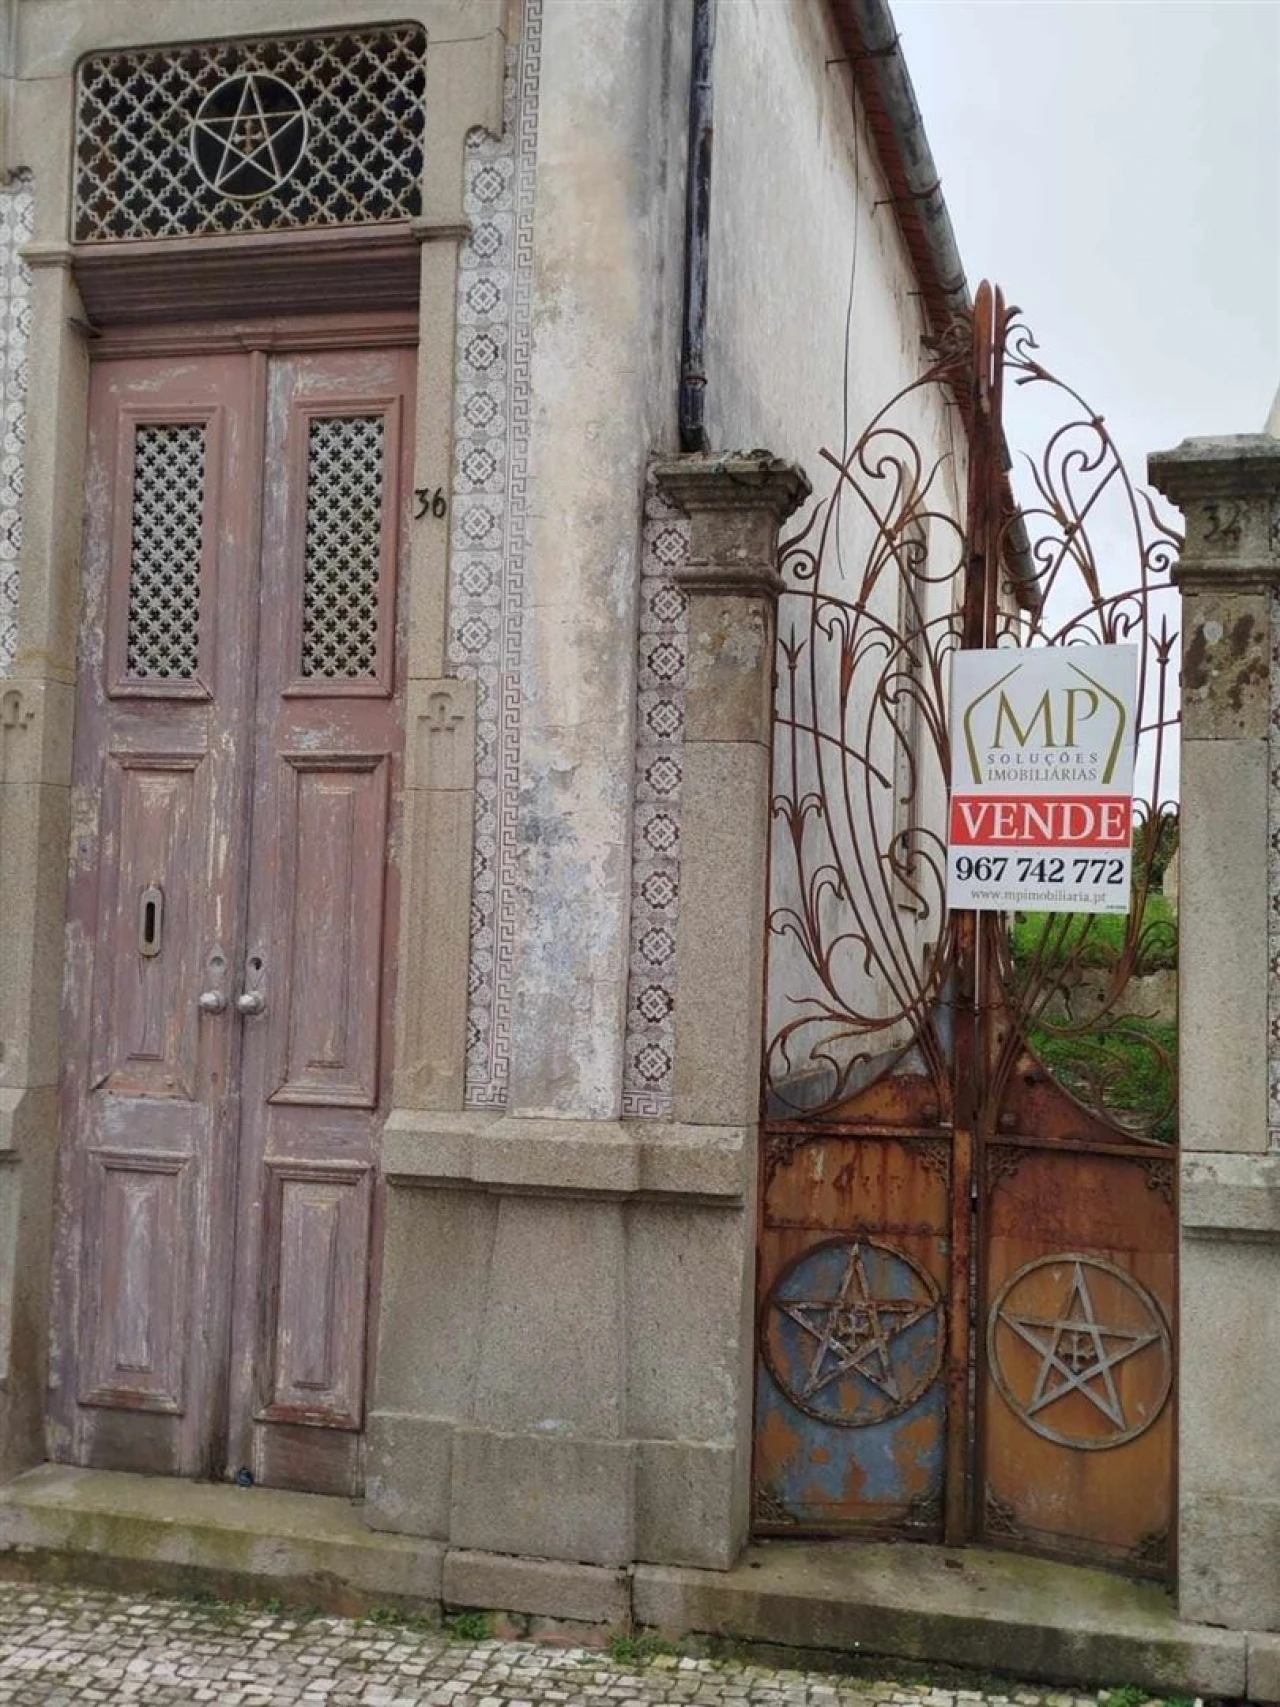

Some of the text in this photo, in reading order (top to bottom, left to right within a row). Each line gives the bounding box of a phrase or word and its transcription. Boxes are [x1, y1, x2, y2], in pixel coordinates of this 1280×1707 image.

[414, 487, 447, 520] 36
[988, 688, 1100, 749] MP
[987, 751, 1099, 767] SOLUÇÕES
[987, 765, 1098, 782] IMOBILIÁRIAS
[958, 802, 1127, 841] VENDE
[955, 856, 1125, 885] 967 742 772
